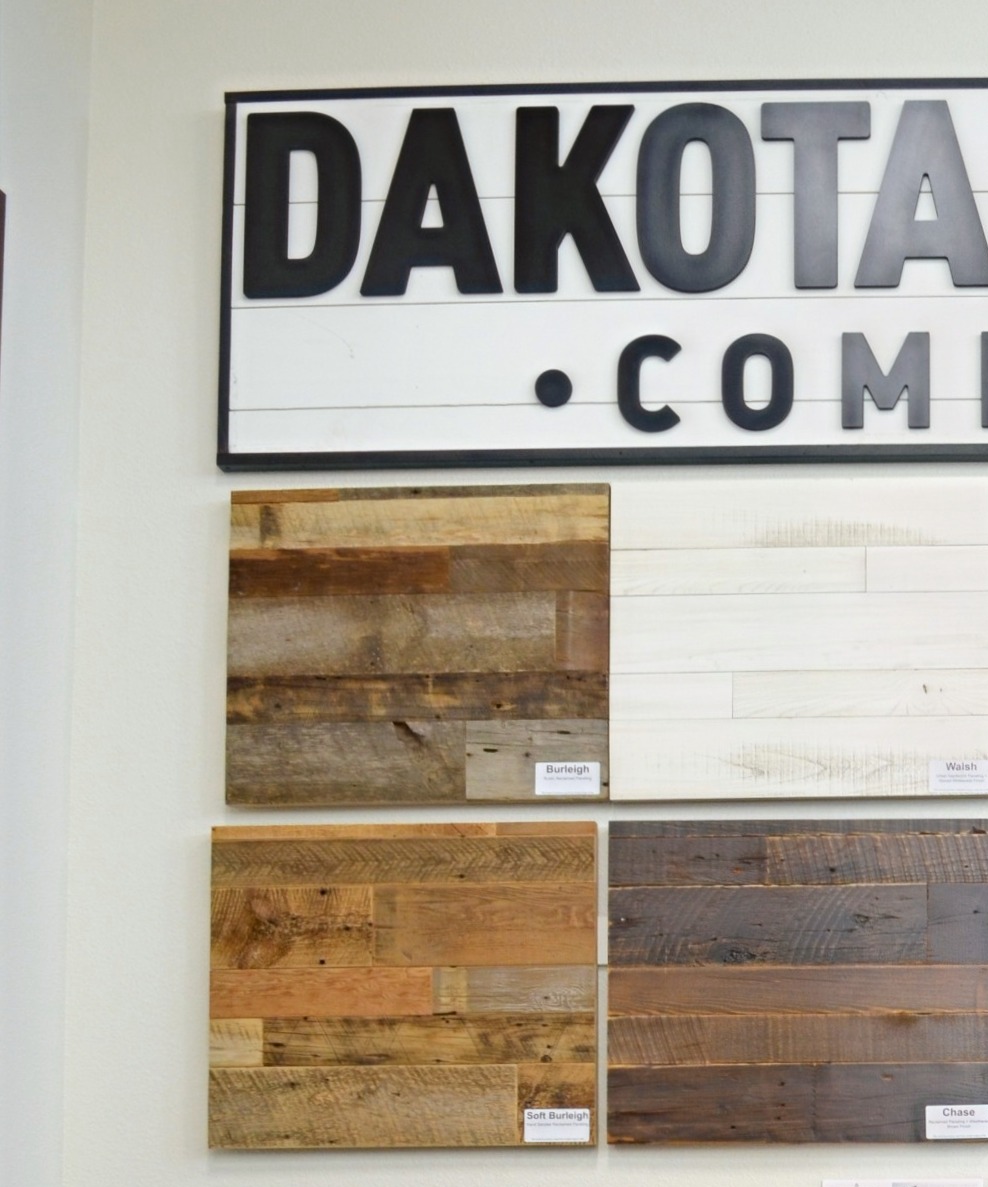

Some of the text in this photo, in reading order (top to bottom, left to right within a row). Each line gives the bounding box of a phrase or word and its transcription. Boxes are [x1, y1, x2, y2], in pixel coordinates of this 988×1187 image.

[546, 764, 590, 775] Burleigh
[945, 761, 978, 771] Walsh
[526, 1110, 589, 1122] Soft Burleigh
[942, 1108, 976, 1117] Chase
